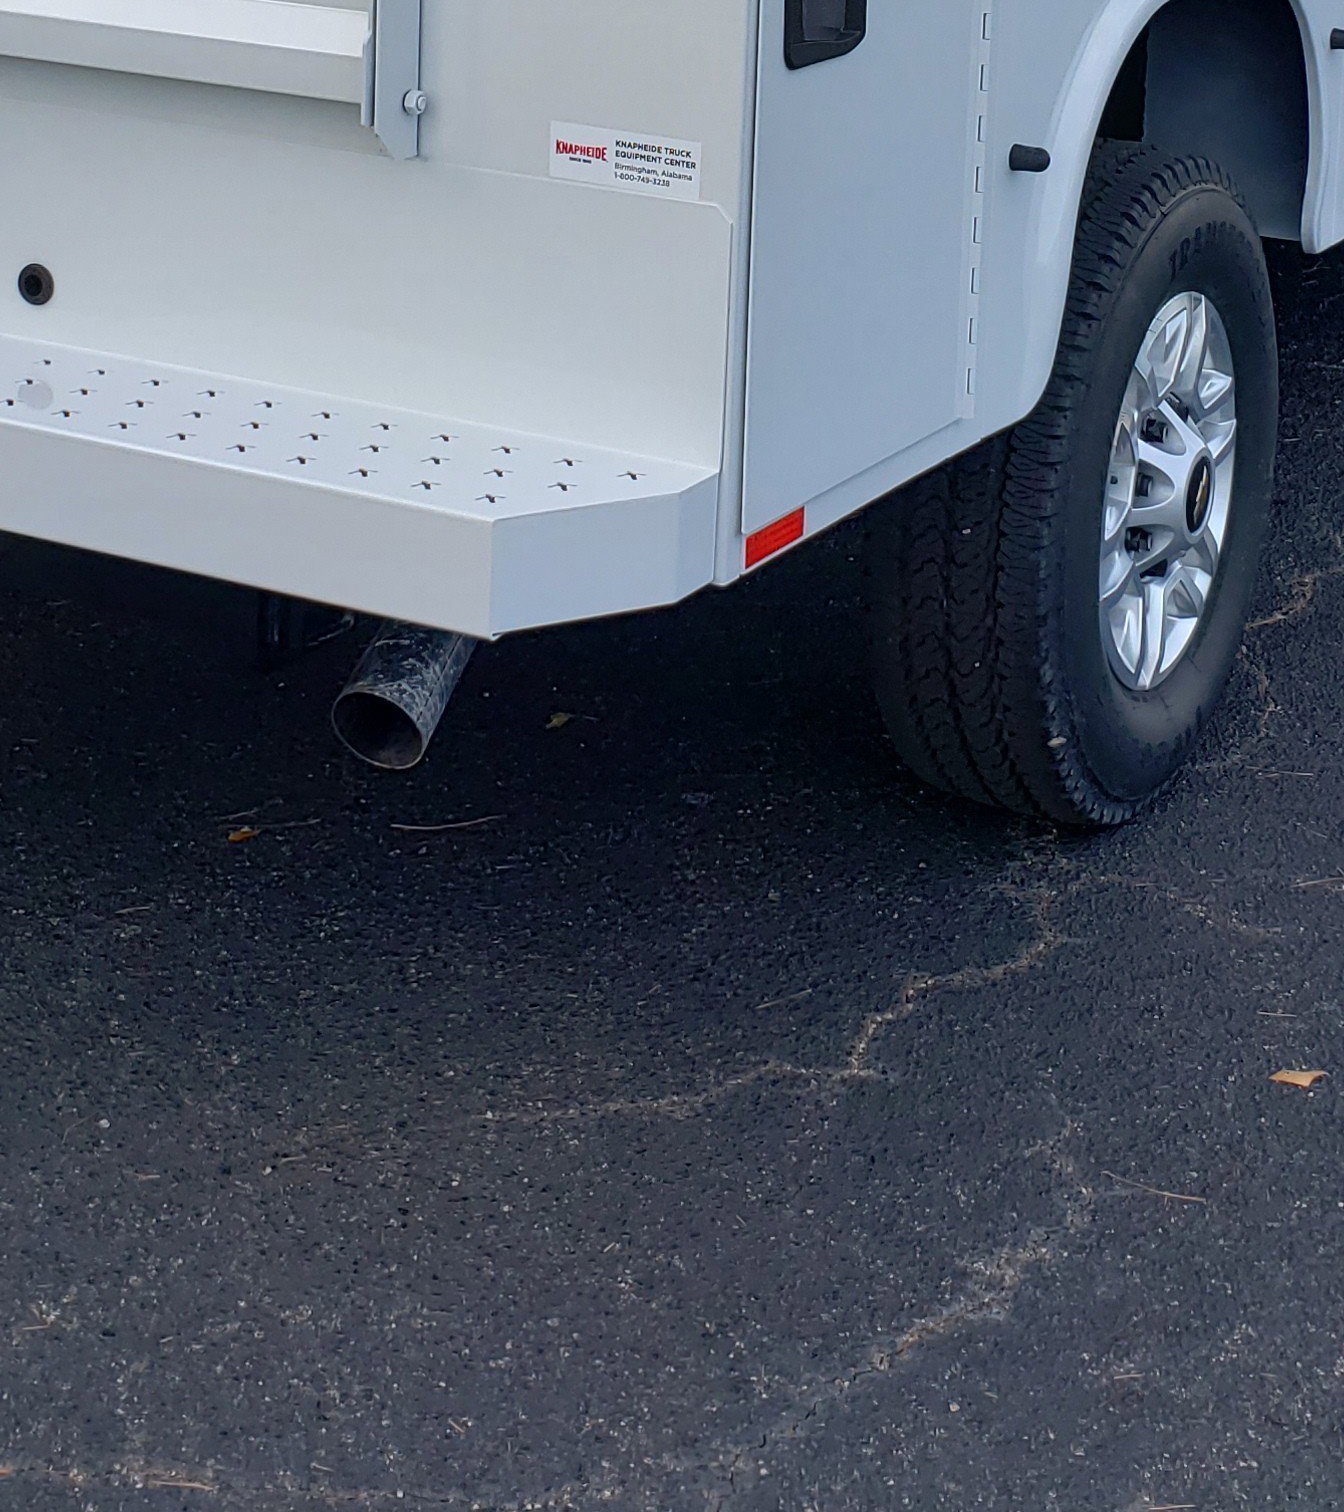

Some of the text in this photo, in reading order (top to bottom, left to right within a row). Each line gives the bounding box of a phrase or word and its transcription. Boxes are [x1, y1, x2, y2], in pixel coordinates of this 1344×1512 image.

[556, 139, 608, 161] KNAPHEIDE
[615, 140, 692, 158] KNAPHEIDE TRUCK
[615, 150, 696, 169] EQUIPMENT CENTER
[614, 162, 692, 181] Birmingham, Alabama
